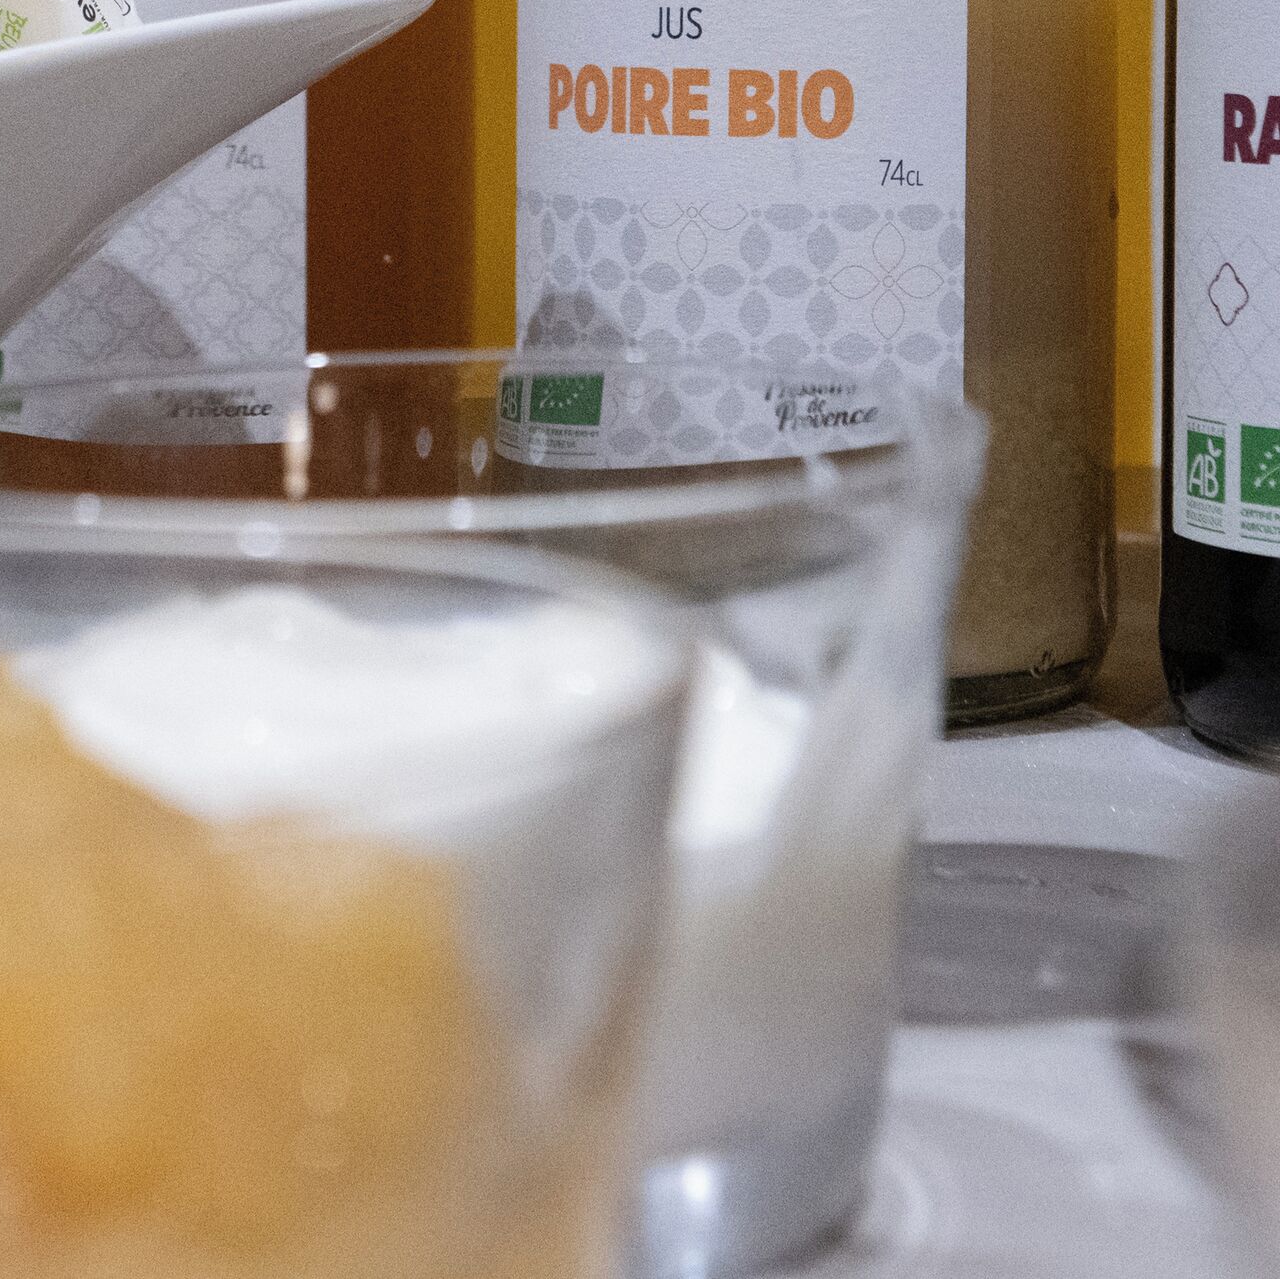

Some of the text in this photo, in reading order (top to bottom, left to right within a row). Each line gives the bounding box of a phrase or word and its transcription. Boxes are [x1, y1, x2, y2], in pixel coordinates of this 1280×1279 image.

[651, 6, 703, 40] JUS
[548, 63, 855, 140] POIRE BIO
[1188, 453, 1219, 498] AB
